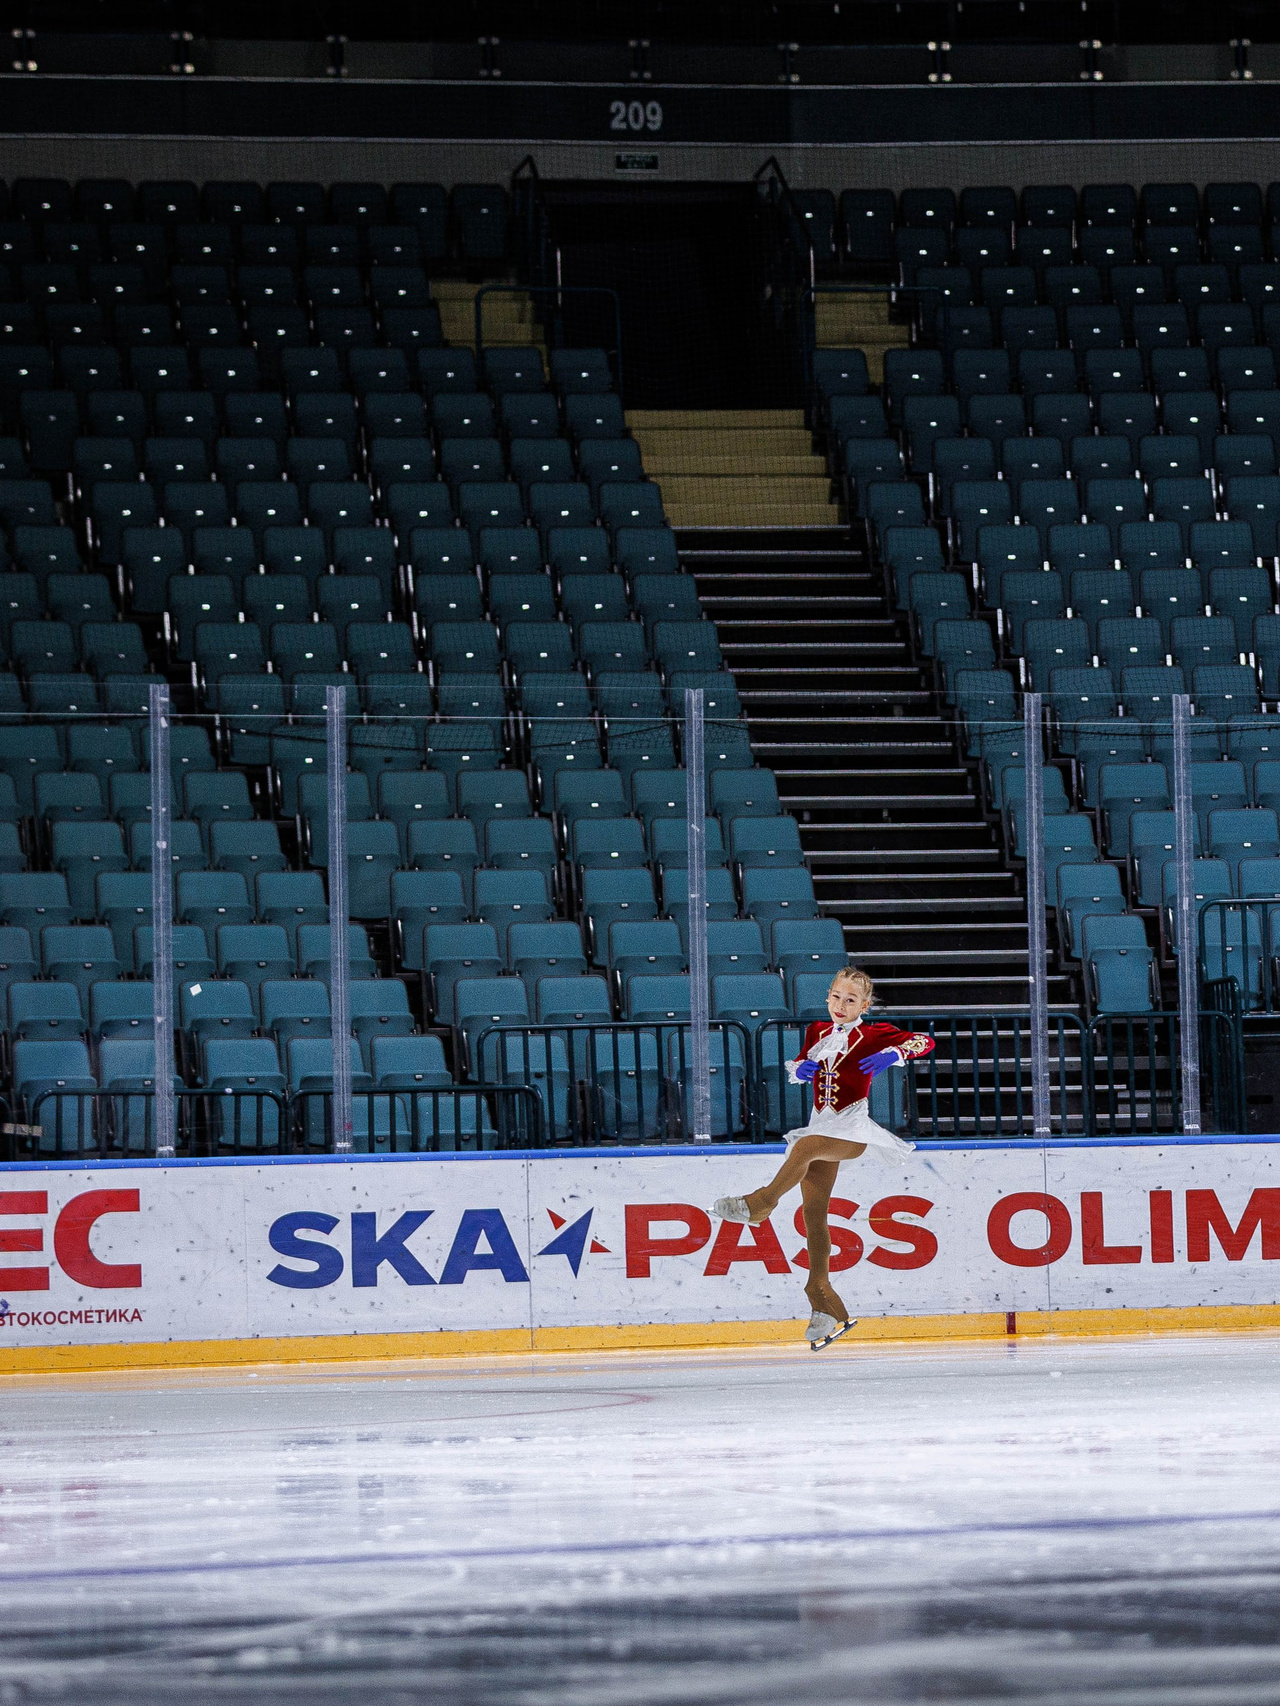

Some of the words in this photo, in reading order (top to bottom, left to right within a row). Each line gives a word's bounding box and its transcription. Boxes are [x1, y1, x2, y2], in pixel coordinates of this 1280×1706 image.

[610, 101, 663, 131] 209
[266, 1208, 531, 1290] SKA
[624, 1194, 939, 1279] PASS
